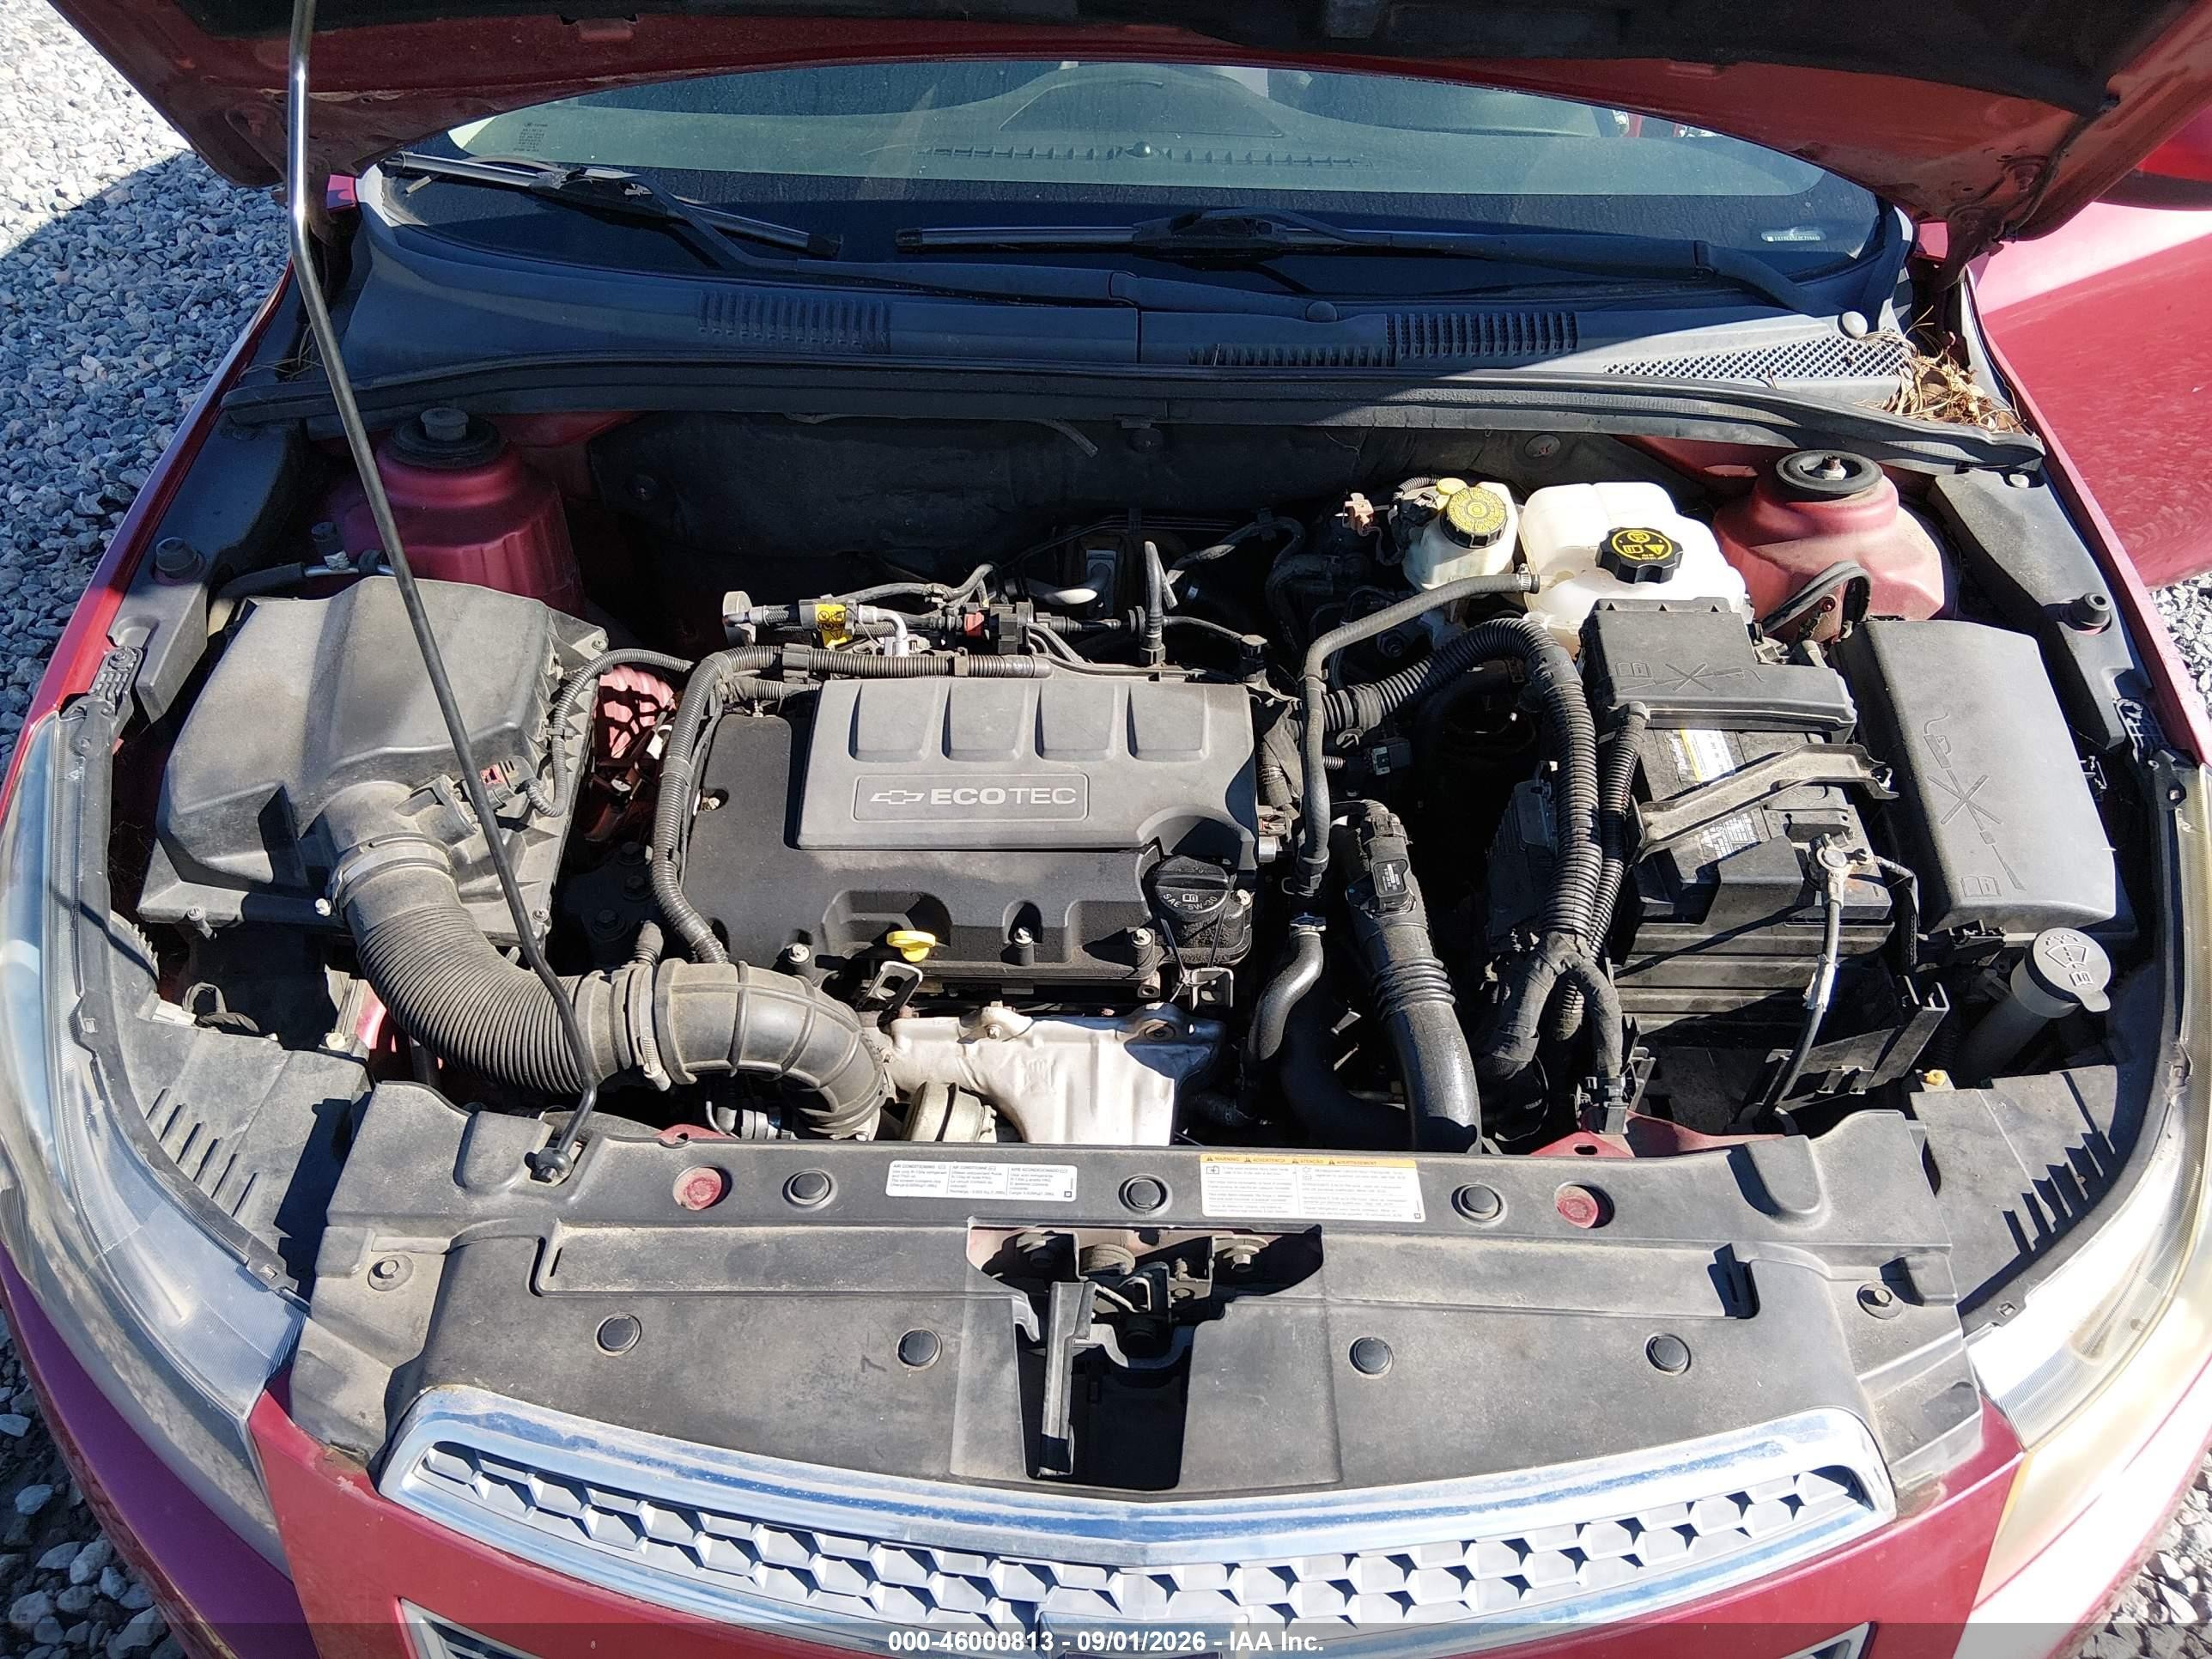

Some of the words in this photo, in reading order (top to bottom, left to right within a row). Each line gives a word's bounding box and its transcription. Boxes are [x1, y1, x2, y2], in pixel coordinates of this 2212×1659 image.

[930, 787, 1077, 805] ECOTEC
[1163, 893, 1182, 908] SAE
[1188, 896, 1218, 910] 5W-30
